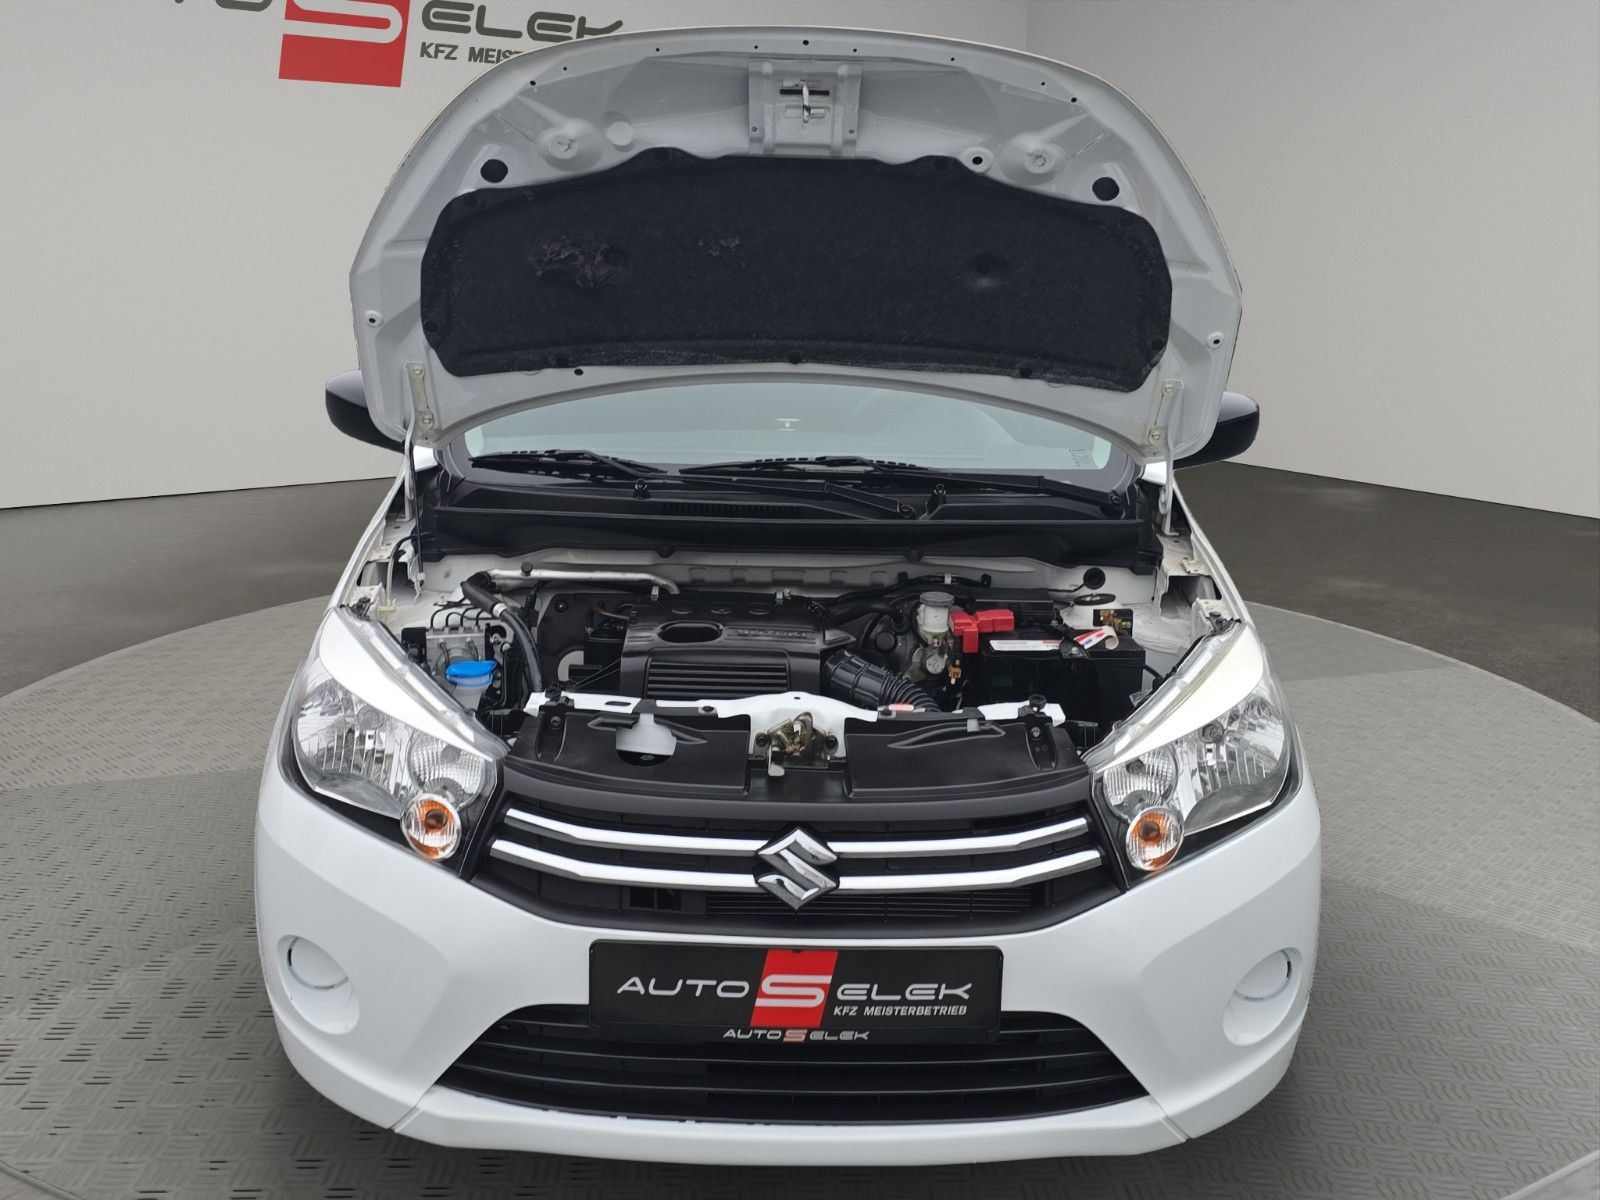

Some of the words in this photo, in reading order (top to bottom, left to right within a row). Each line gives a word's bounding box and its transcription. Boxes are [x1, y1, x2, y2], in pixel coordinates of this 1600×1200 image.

[420, 42, 458, 60] KFZ
[617, 976, 750, 998] AUTO
[833, 1005, 859, 1016] KFZ
[863, 1005, 967, 1016] MEISTERBETRIEB
[723, 1029, 782, 1040] AUTO
